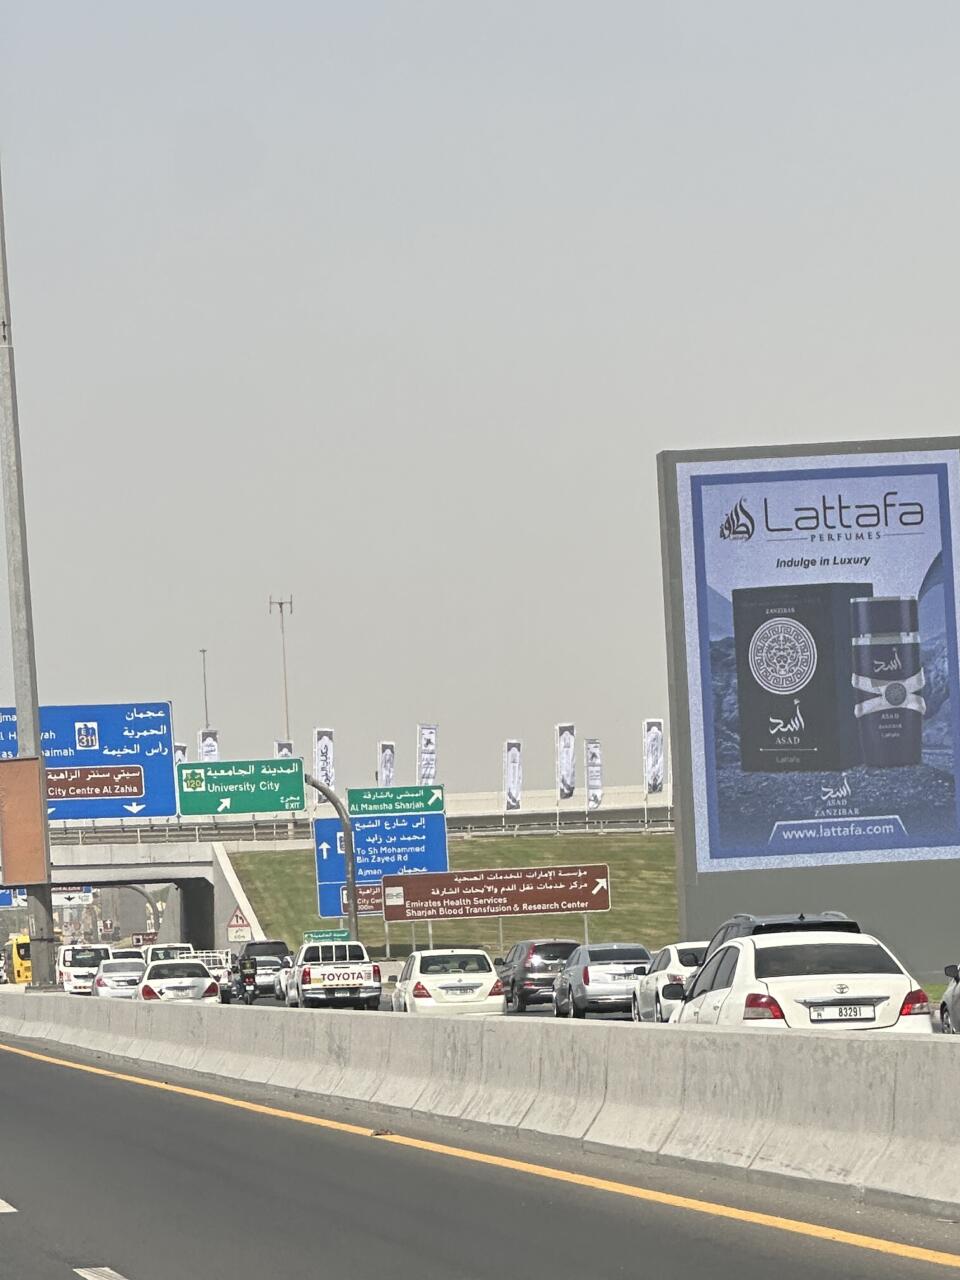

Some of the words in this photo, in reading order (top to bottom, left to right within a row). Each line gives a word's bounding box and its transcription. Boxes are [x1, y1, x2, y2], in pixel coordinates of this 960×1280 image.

[763, 491, 925, 532] Lattafa
[810, 531, 882, 542] PERFUMES
[776, 557, 817, 569] Indulge
[819, 556, 830, 566] in
[833, 555, 871, 567] Luxury
[125, 707, 165, 721] عجمان
[122, 725, 167, 739] الحمرية
[78, 735, 96, 746] 311
[775, 736, 801, 745] ASAD
[102, 744, 140, 757] الخيمة
[145, 742, 169, 756] رأس
[47, 770, 80, 781] الزاهية
[86, 770, 110, 781] سنتر
[113, 769, 140, 782] سيتي
[206, 765, 255, 778] الجامعية
[261, 763, 298, 777] المدينة
[186, 780, 201, 788] 120
[207, 782, 256, 793] University
[259, 781, 280, 791] City
[48, 787, 66, 797] City
[68, 786, 100, 795] Centre
[102, 785, 112, 794] Al
[114, 784, 138, 793] Zahia
[360, 802, 393, 811] Mamsha
[394, 801, 425, 810] Sharjah
[814, 808, 860, 817] ZANZIBAR
[354, 819, 380, 831] الشيخ
[384, 818, 408, 830] شارع
[411, 817, 426, 829] إلى
[399, 833, 426, 841] محمد
[782, 823, 894, 840] www.lattafa.com
[365, 833, 382, 844] زايد
[380, 845, 425, 854] Mohammed
[371, 855, 395, 864] Zayed
[358, 868, 382, 876] Ajman
[486, 872, 522, 881] للخدمات
[525, 870, 556, 881] الإمارات
[558, 868, 588, 878] مؤسسة
[453, 873, 484, 883] الصحية
[500, 883, 517, 896] الدم
[519, 882, 534, 893] نقل
[536, 882, 565, 890] خدمات
[568, 881, 588, 890] مركز
[431, 887, 460, 896] الشارقة
[405, 899, 441, 908] Emirates
[443, 898, 472, 906] Health
[473, 896, 508, 905] Services
[405, 908, 437, 917] Sharjah
[439, 907, 464, 915] Blood
[465, 904, 512, 914] Transfusion
[513, 904, 520, 912] &
[522, 902, 559, 911] Research
[560, 900, 589, 909] Center
[320, 972, 364, 981] TOYOTA
[838, 1007, 862, 1017] 83291
